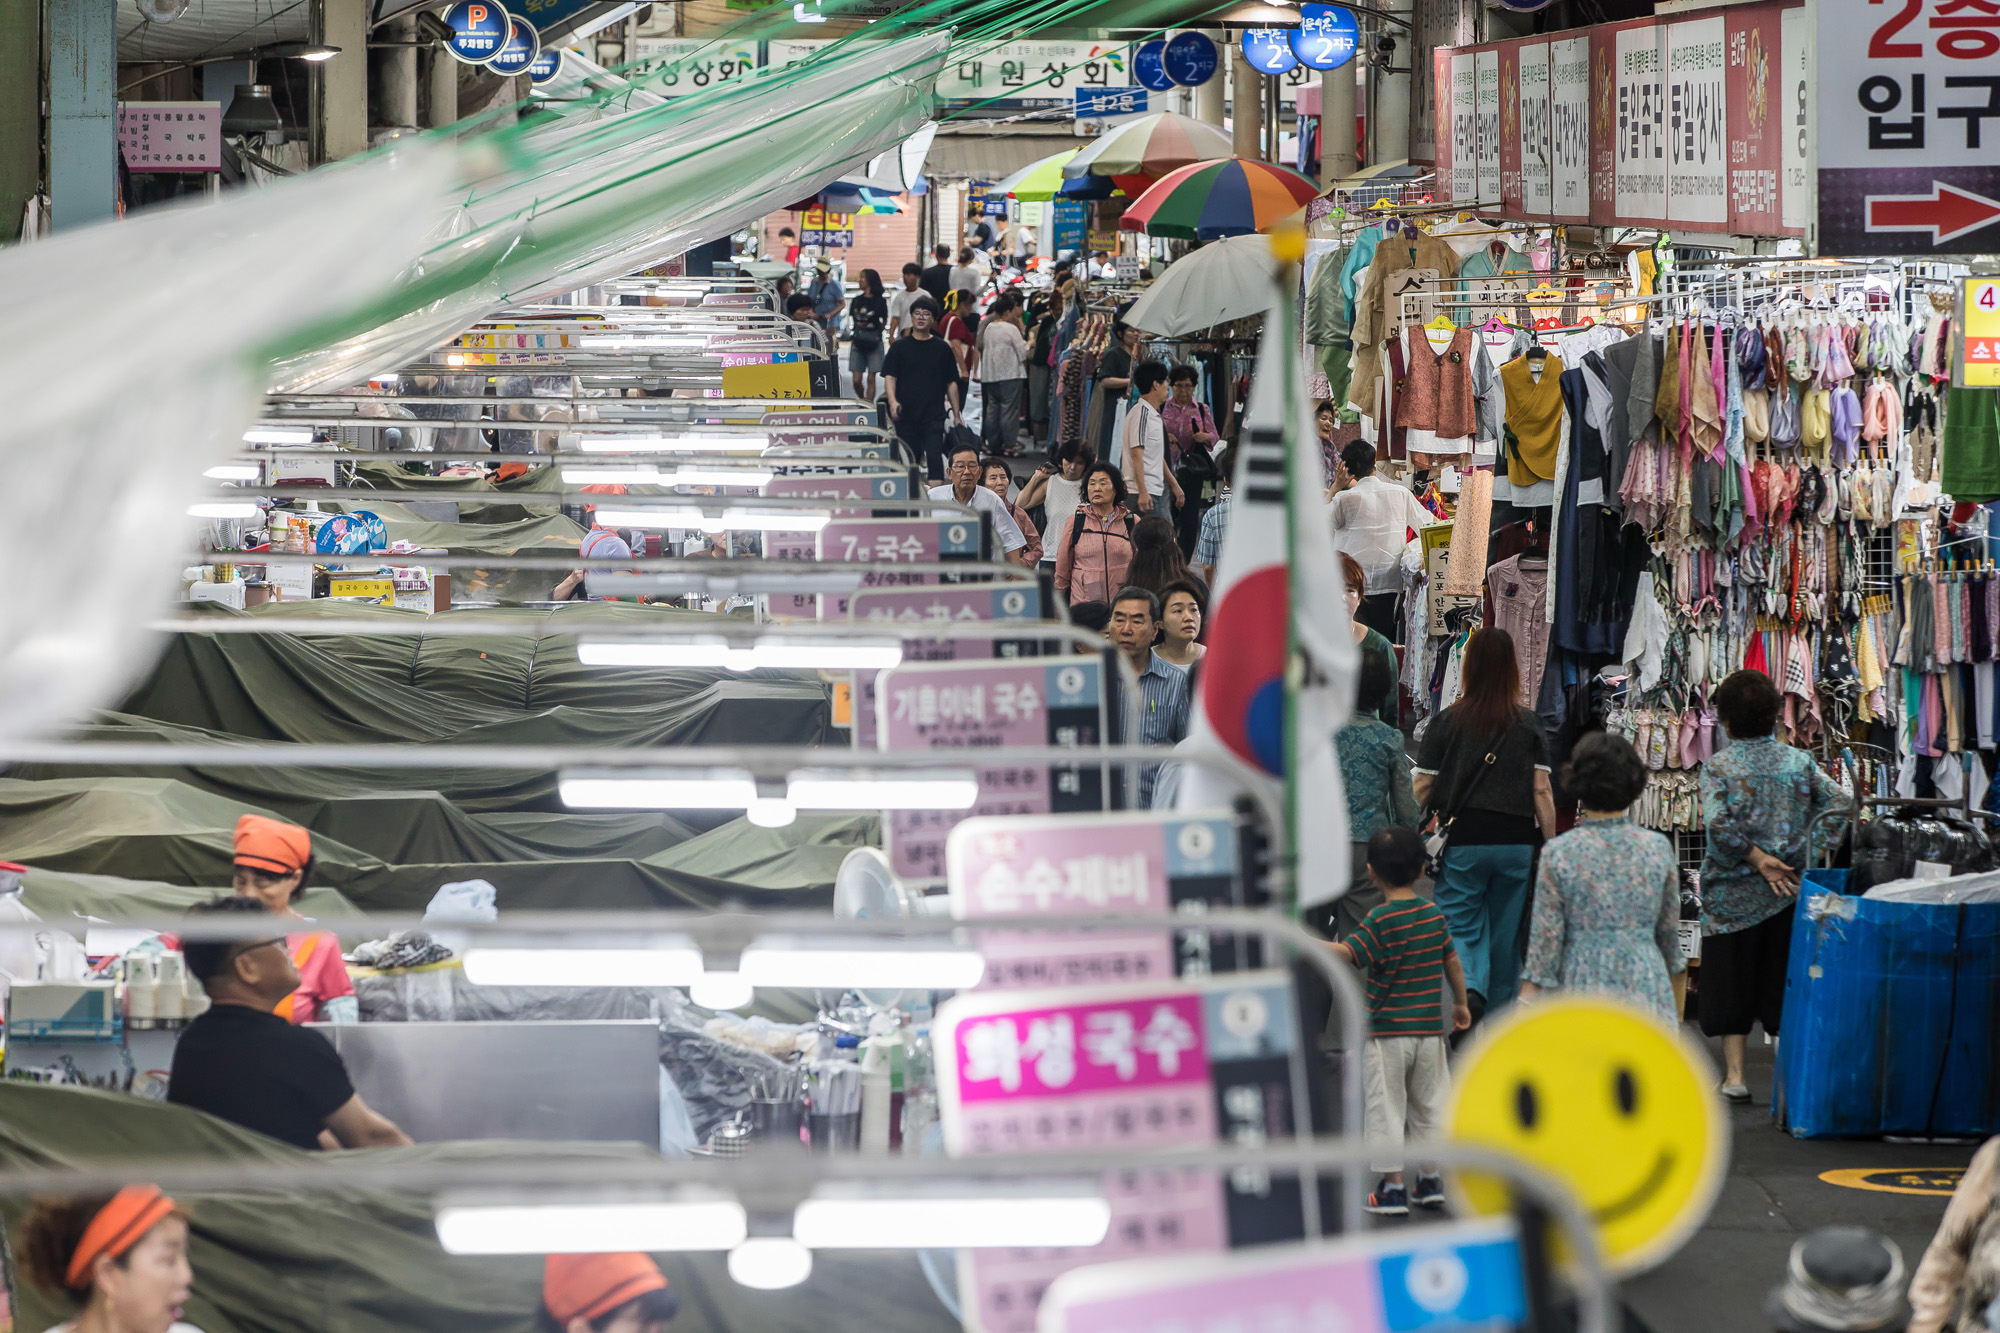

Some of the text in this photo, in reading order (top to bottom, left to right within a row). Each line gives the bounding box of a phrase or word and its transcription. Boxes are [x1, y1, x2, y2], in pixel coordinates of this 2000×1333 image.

[468, 5, 488, 30] P
[855, 4, 891, 14] Meeting
[459, 39, 494, 50] 주차빌딩
[528, 65, 550, 75] 차빌딩
[1153, 68, 1164, 87] 2
[1091, 95, 1135, 112] 남2문
[1858, 74, 2000, 150] 입구
[1619, 82, 1664, 164] 동일주단
[1671, 80, 1722, 165] 동일상사
[1980, 287, 1995, 308] 4
[873, 534, 925, 563] 국수
[1434, 571, 1445, 591] 도포
[1434, 597, 1445, 629] 안동포
[991, 682, 1041, 721] 국수
[976, 850, 1150, 914] 손수제비
